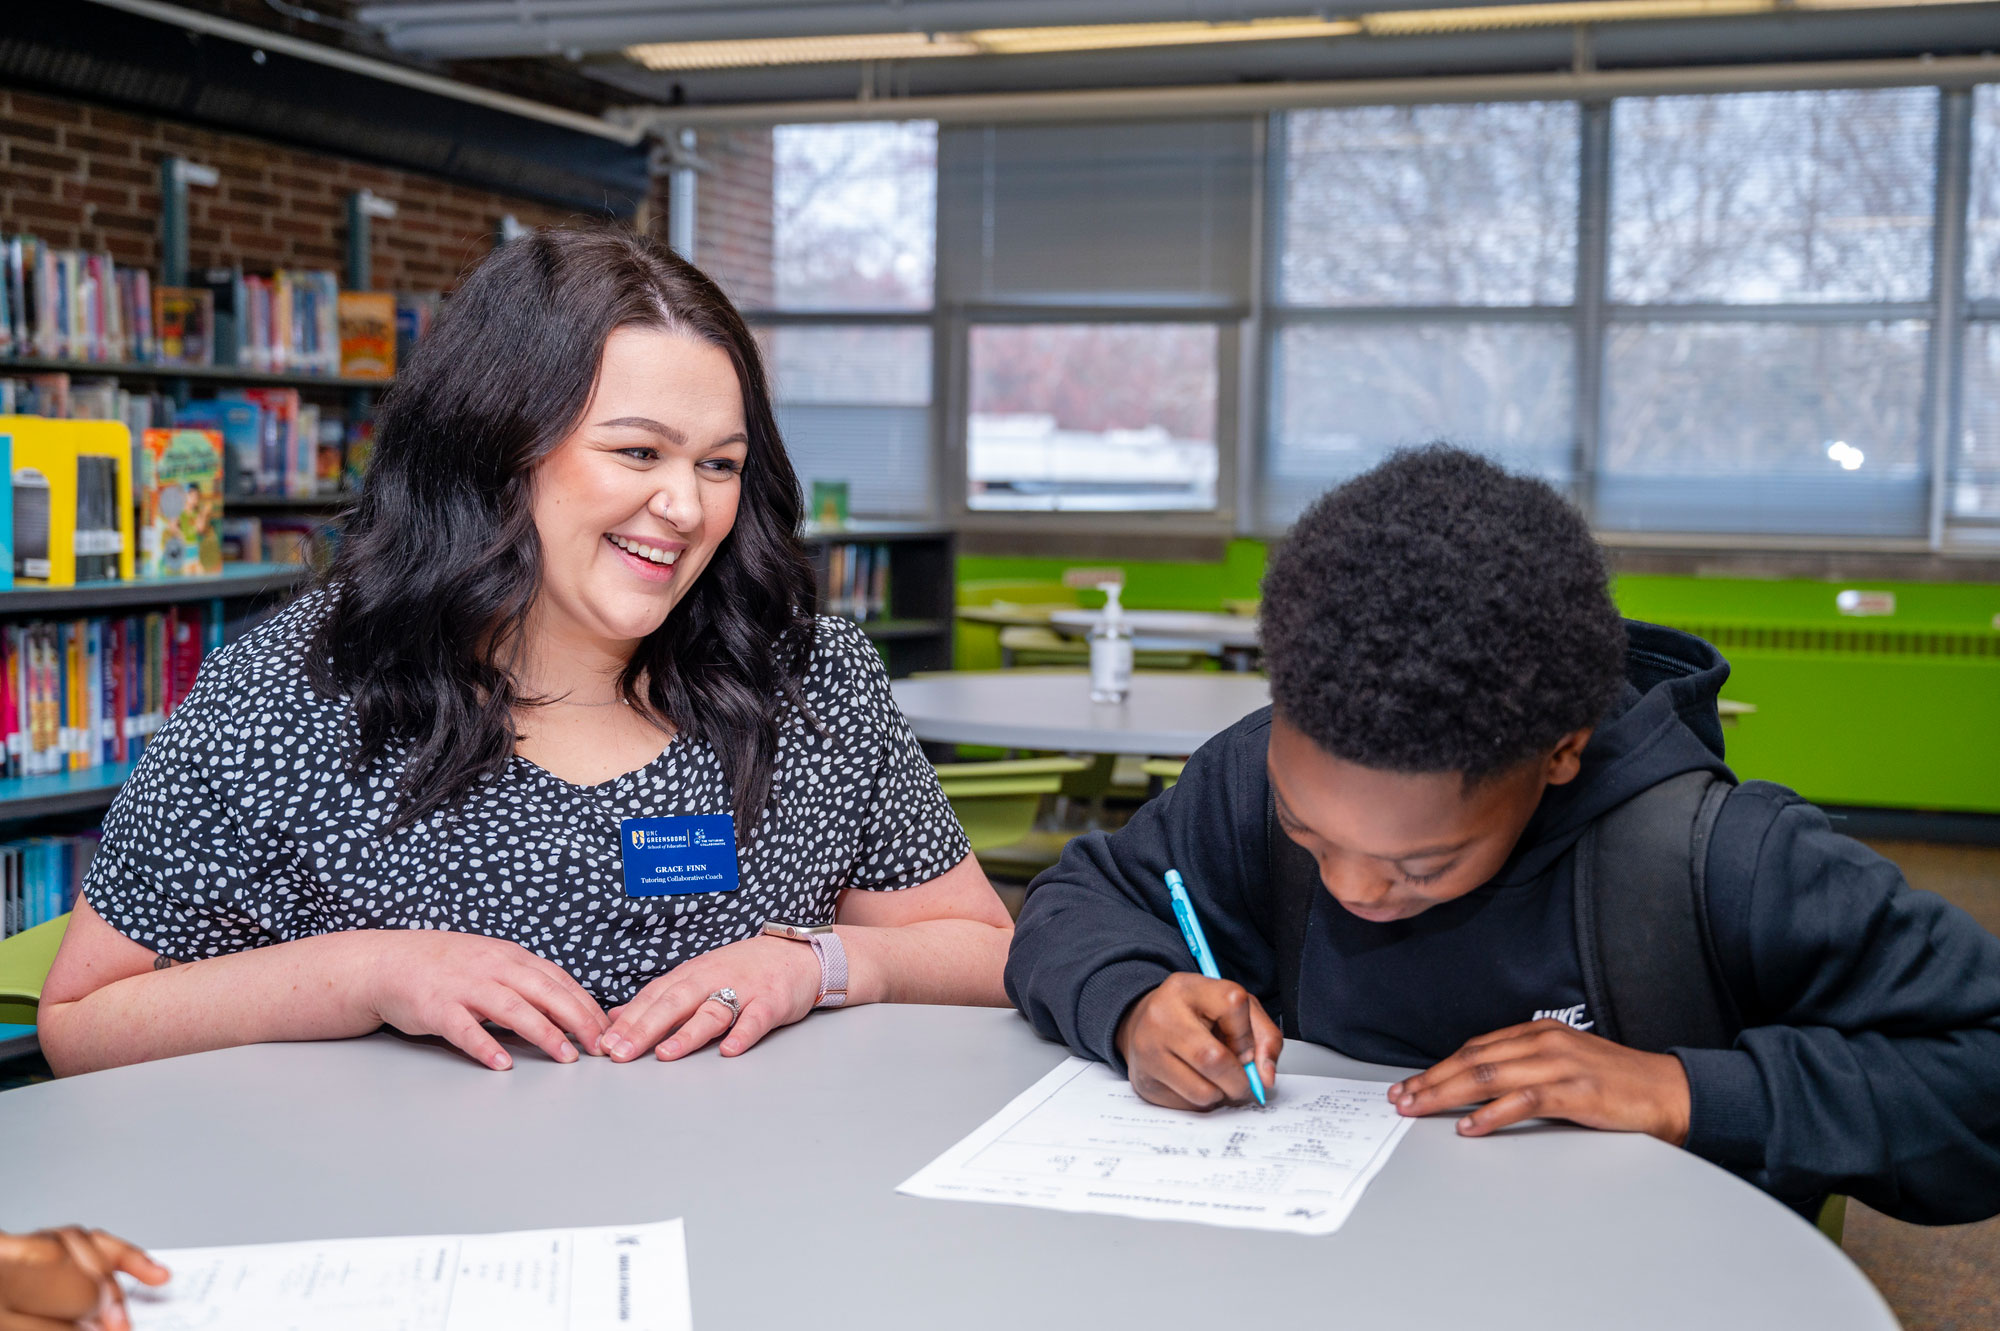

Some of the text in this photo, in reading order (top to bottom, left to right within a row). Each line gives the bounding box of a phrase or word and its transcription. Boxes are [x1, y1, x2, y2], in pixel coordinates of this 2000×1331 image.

[655, 864, 707, 873] GRACE FINN
[666, 874, 705, 882] Collaborative
